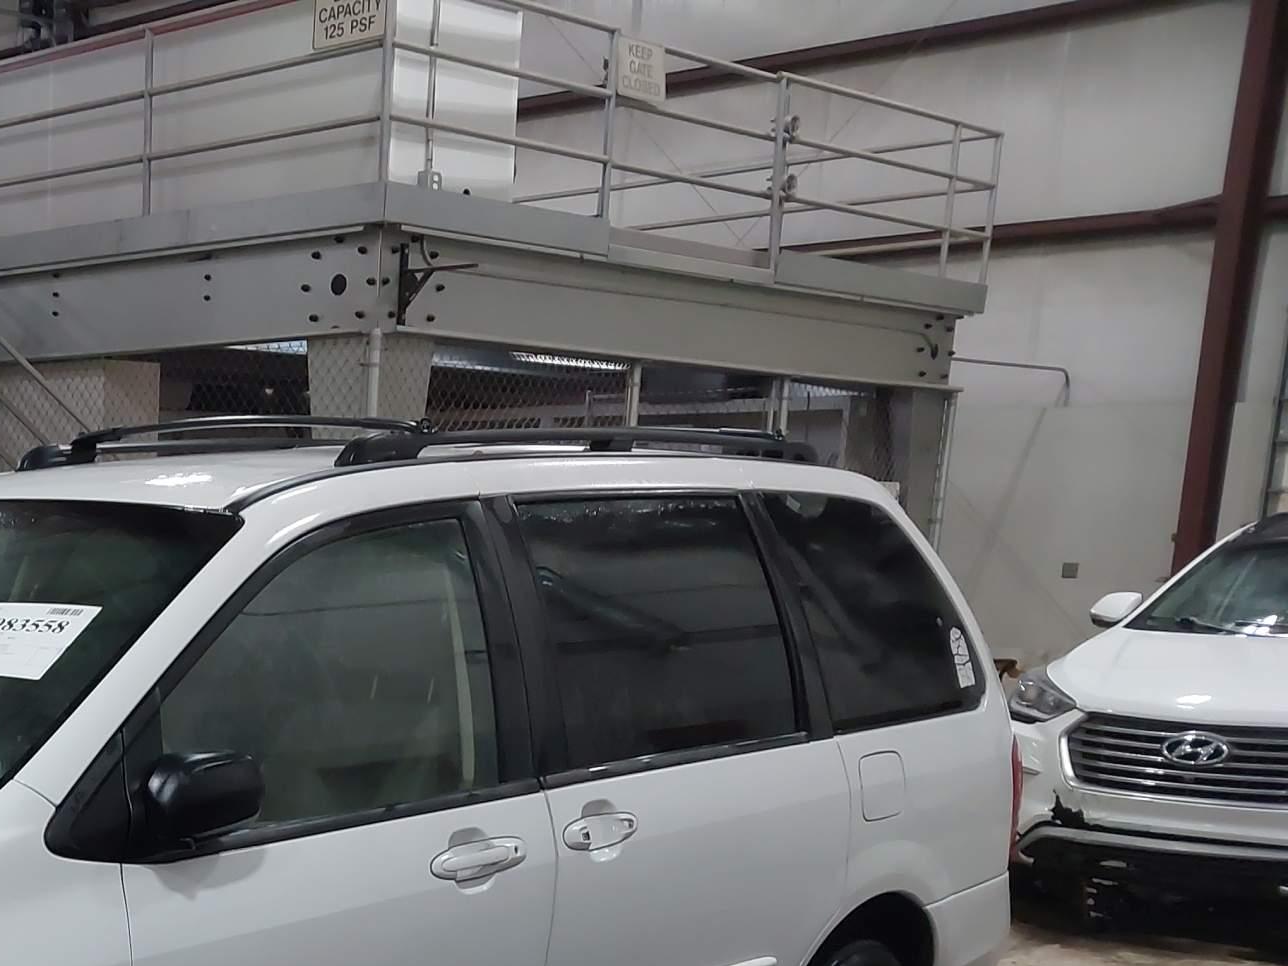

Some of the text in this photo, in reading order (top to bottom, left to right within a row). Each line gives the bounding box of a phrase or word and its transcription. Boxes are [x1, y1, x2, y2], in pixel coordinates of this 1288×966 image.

[318, 0, 381, 23] CAPACITY
[324, 15, 376, 40] 125 PSF
[628, 44, 653, 60] KEEP
[629, 59, 654, 79] GATE
[622, 75, 661, 97] CLOSED
